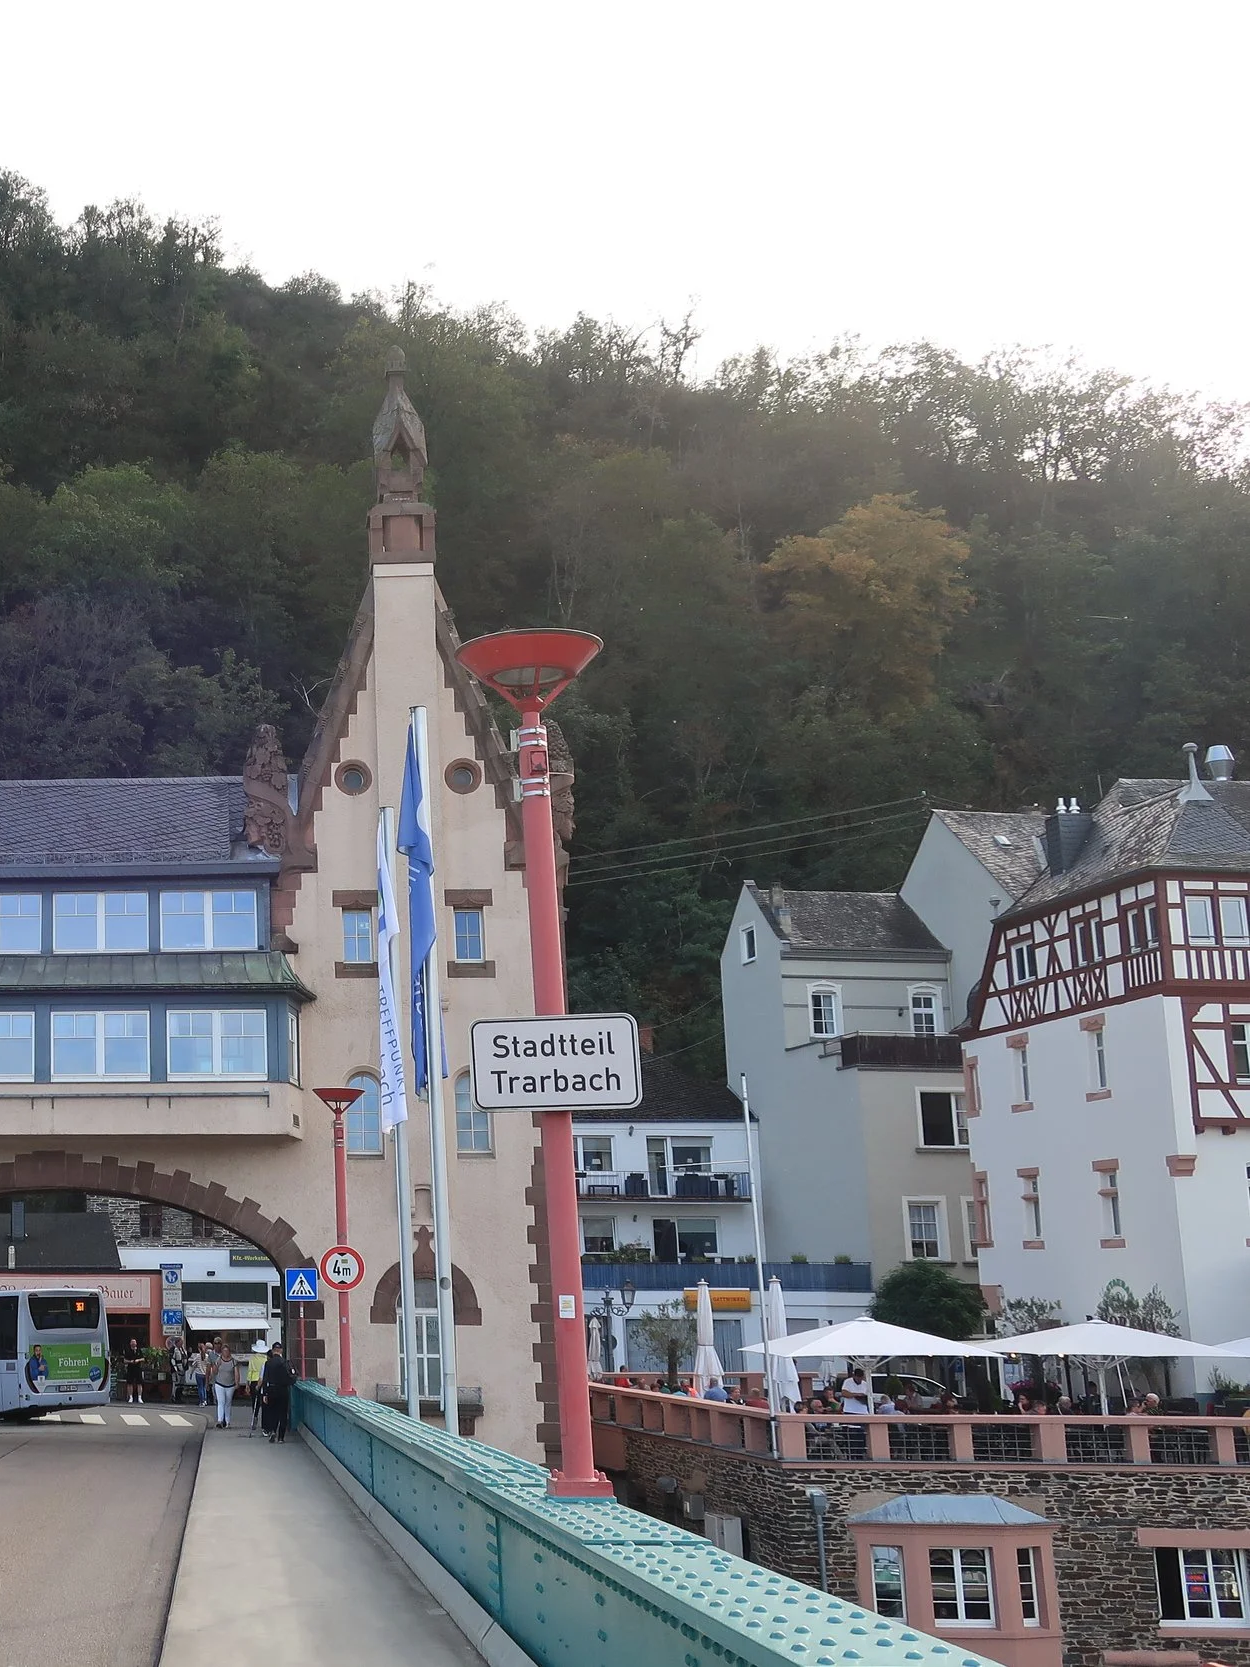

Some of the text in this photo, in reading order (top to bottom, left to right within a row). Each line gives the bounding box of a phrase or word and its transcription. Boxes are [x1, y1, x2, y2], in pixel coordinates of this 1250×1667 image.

[492, 1031, 615, 1059] Stadtteil
[490, 1067, 621, 1094] Trarbach
[98, 1285, 134, 1299] Bauer
[58, 1357, 89, 1367] Föhren!
